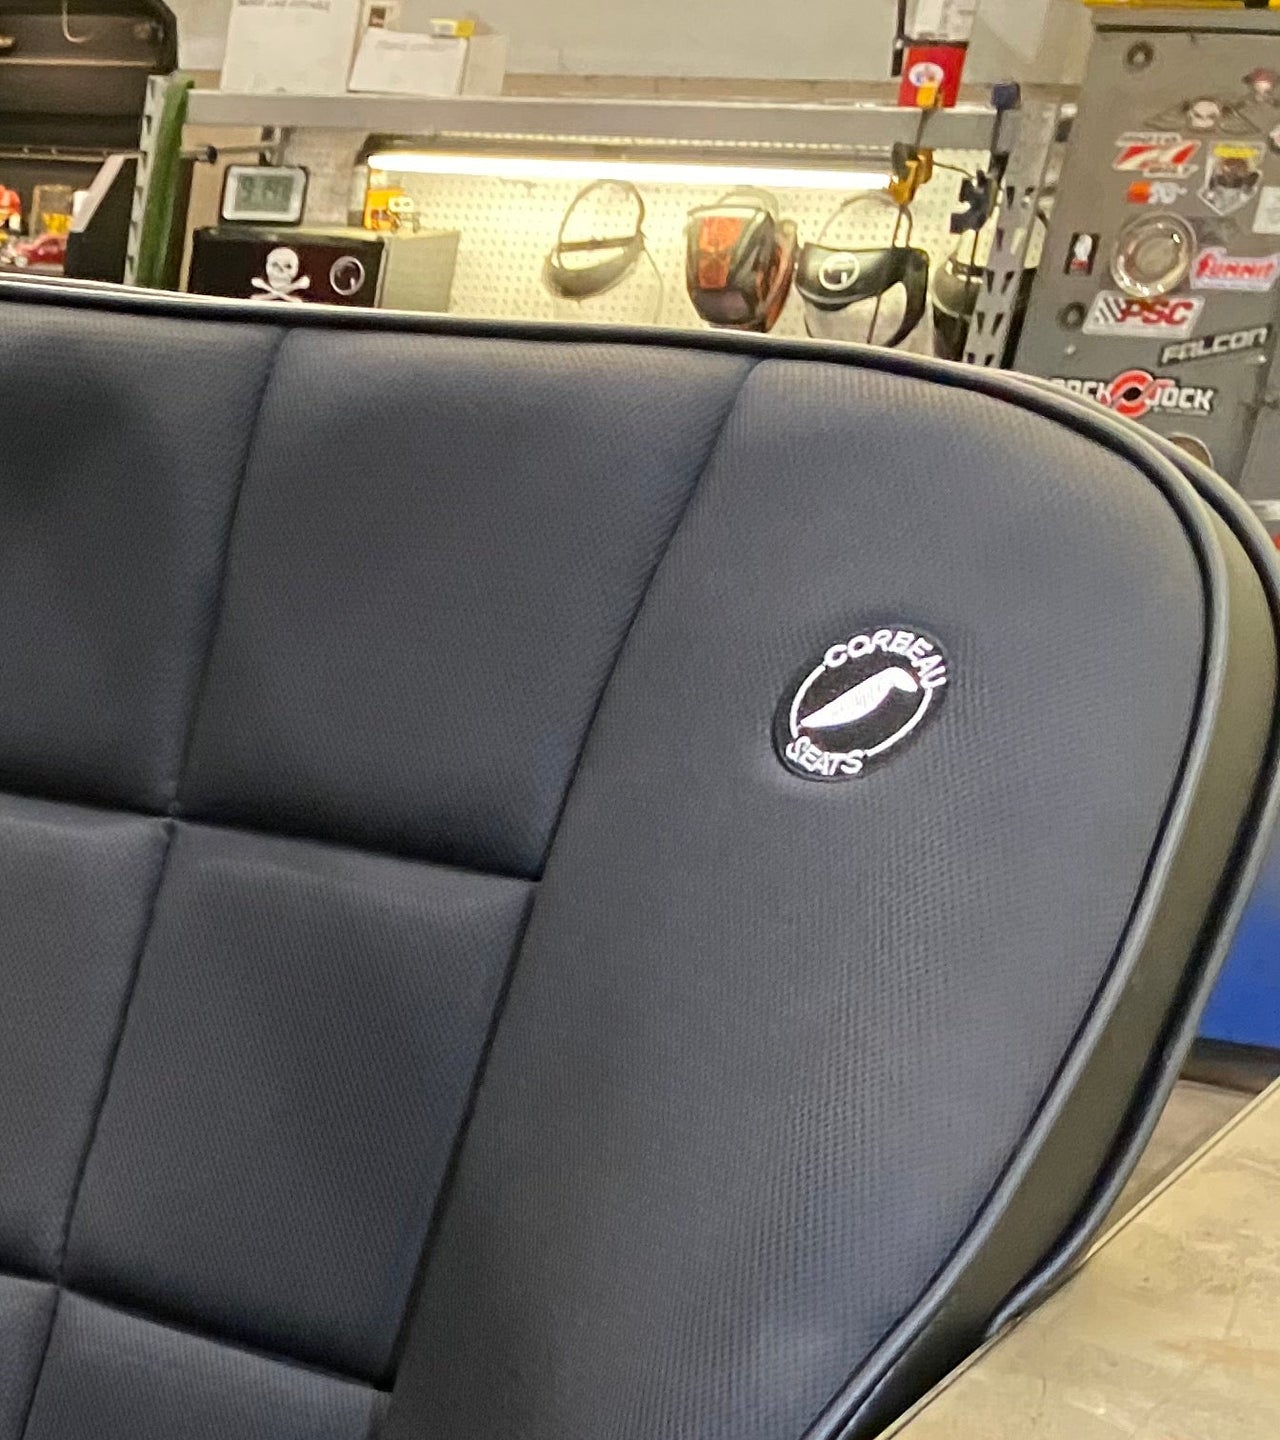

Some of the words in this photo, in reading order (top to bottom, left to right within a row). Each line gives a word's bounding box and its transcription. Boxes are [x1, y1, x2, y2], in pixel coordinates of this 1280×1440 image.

[1161, 327, 1268, 364] FALCON
[823, 628, 947, 689] CORBEAU
[785, 735, 864, 776] SEATS
